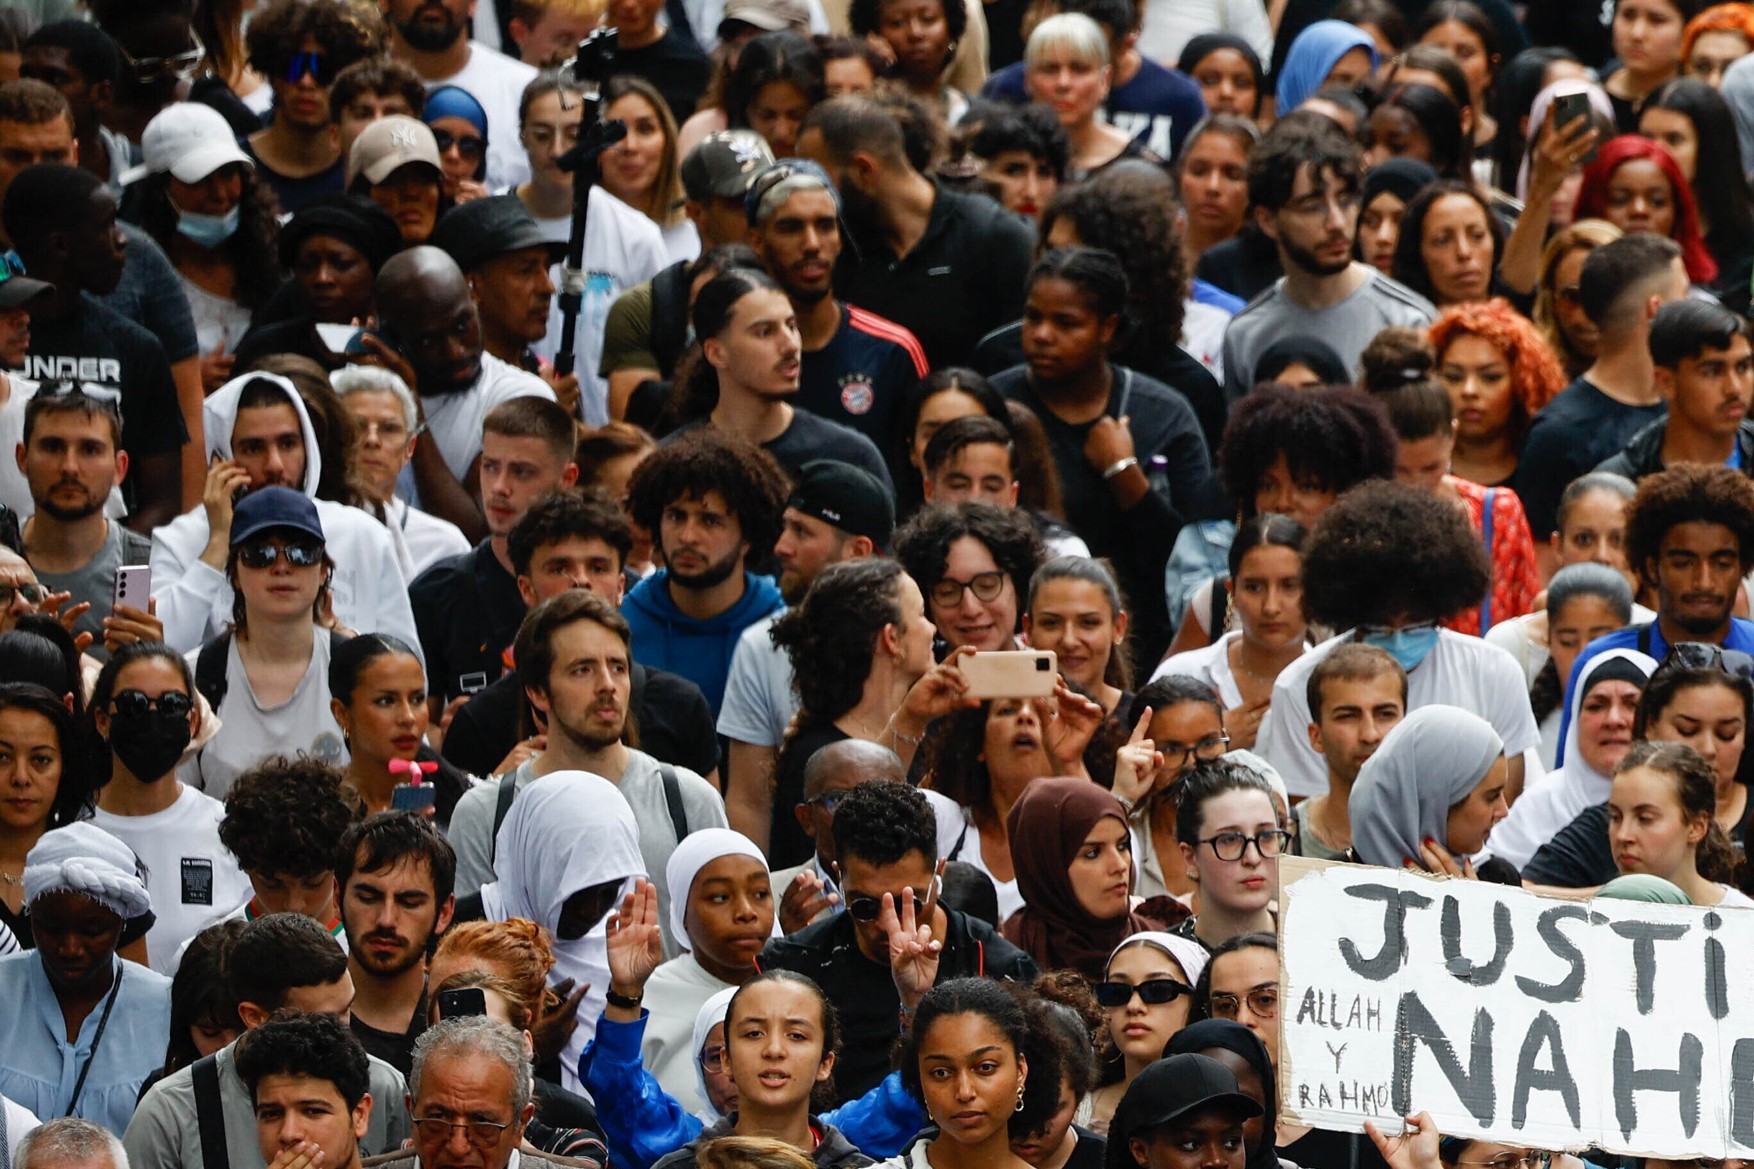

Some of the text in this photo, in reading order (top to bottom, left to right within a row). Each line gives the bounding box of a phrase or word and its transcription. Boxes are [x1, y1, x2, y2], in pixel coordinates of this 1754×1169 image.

[1297, 986, 1381, 1032] ALLAH
[1326, 1040, 1348, 1074] Y
[1298, 1079, 1389, 1116] RAHMO
